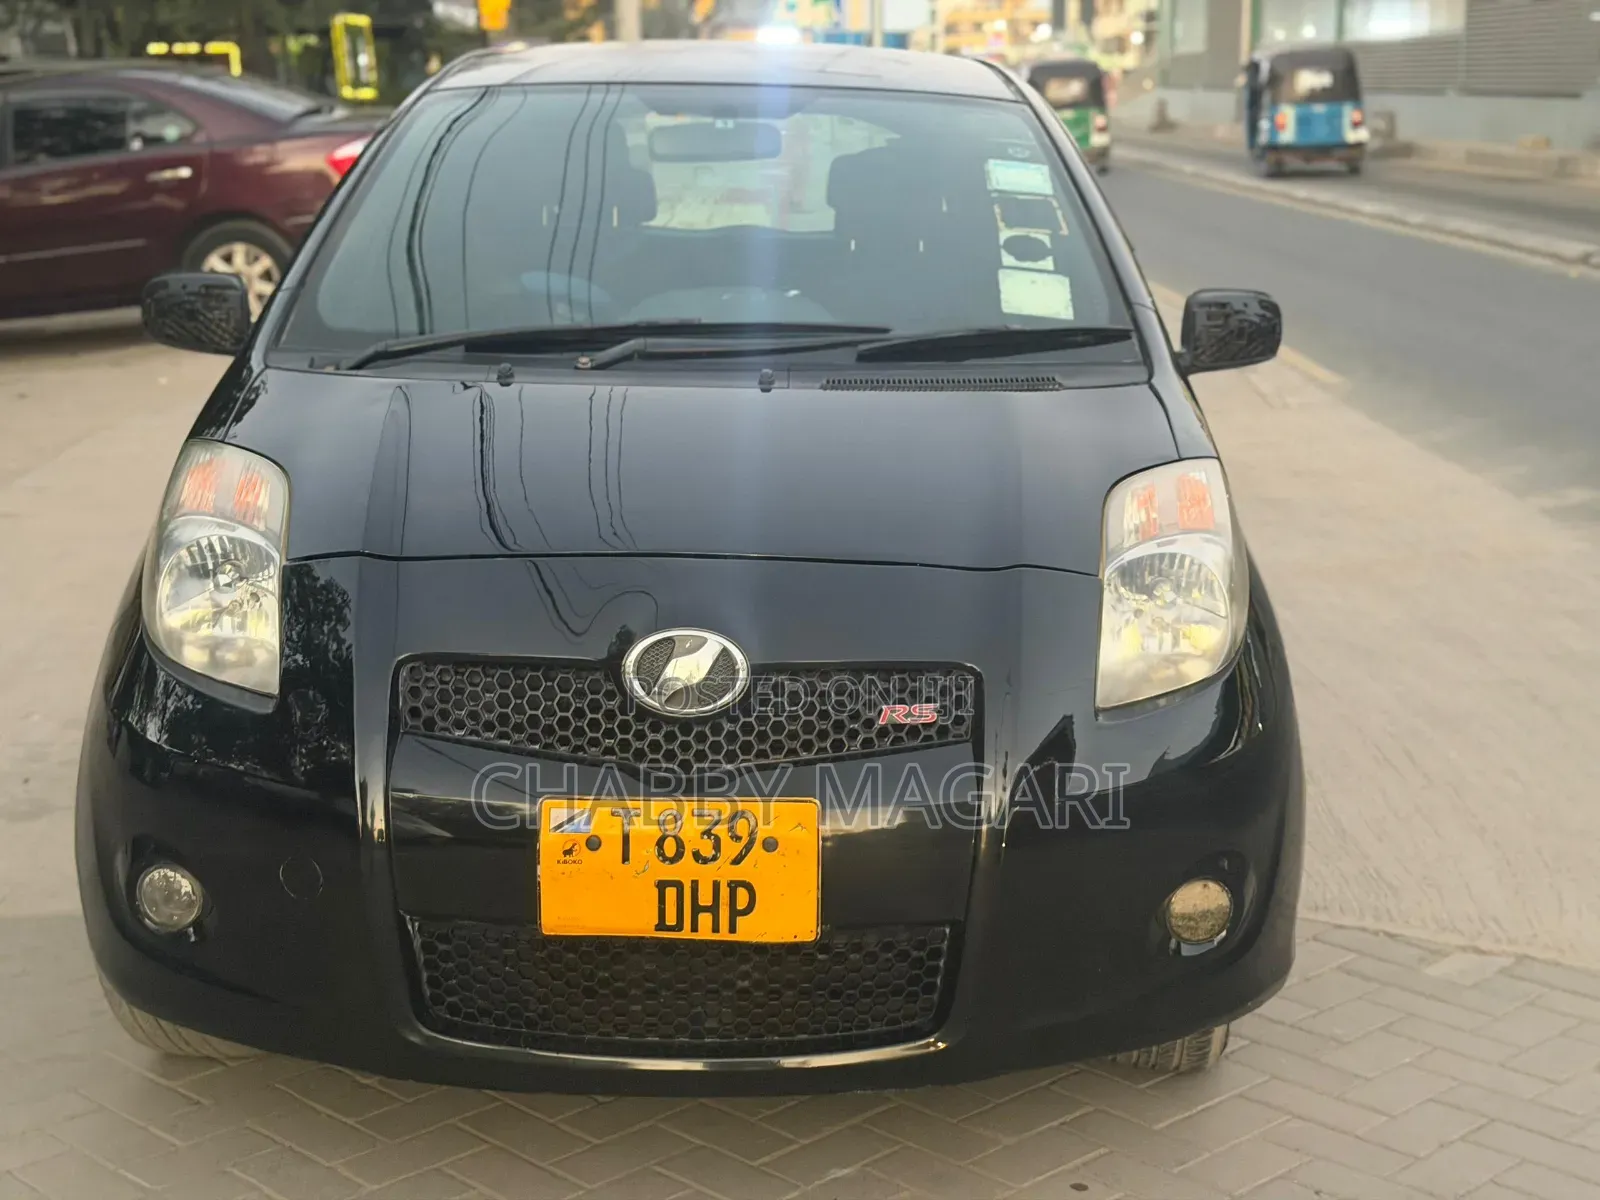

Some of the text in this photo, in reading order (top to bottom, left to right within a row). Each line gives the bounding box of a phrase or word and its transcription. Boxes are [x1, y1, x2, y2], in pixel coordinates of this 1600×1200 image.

[878, 703, 939, 725] RS
[610, 807, 759, 867] T 839
[653, 878, 757, 934] DHP
